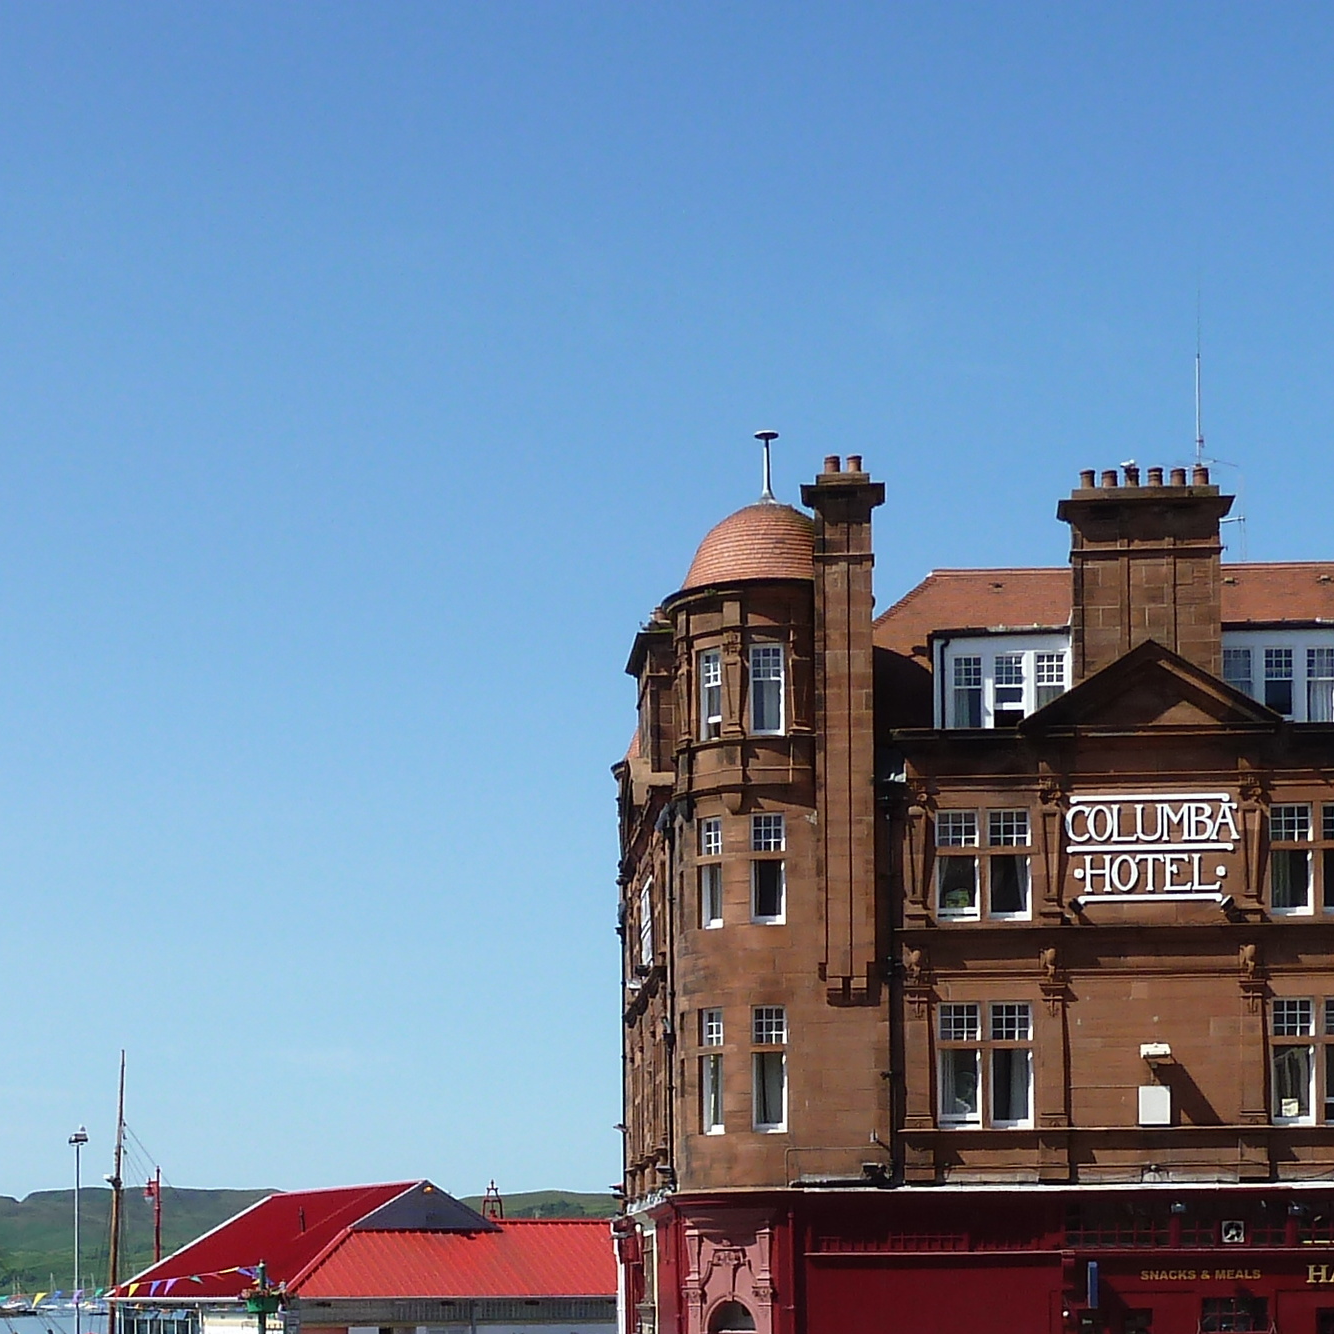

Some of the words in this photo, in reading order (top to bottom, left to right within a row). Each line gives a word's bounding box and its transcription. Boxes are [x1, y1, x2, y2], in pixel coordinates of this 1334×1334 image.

[1065, 803, 1241, 842] COLUMBA
[1084, 854, 1221, 892] HOTEL
[1140, 1270, 1196, 1280] SNACKS
[1201, 1270, 1210, 1280] &
[1215, 1269, 1261, 1280] MEALS
